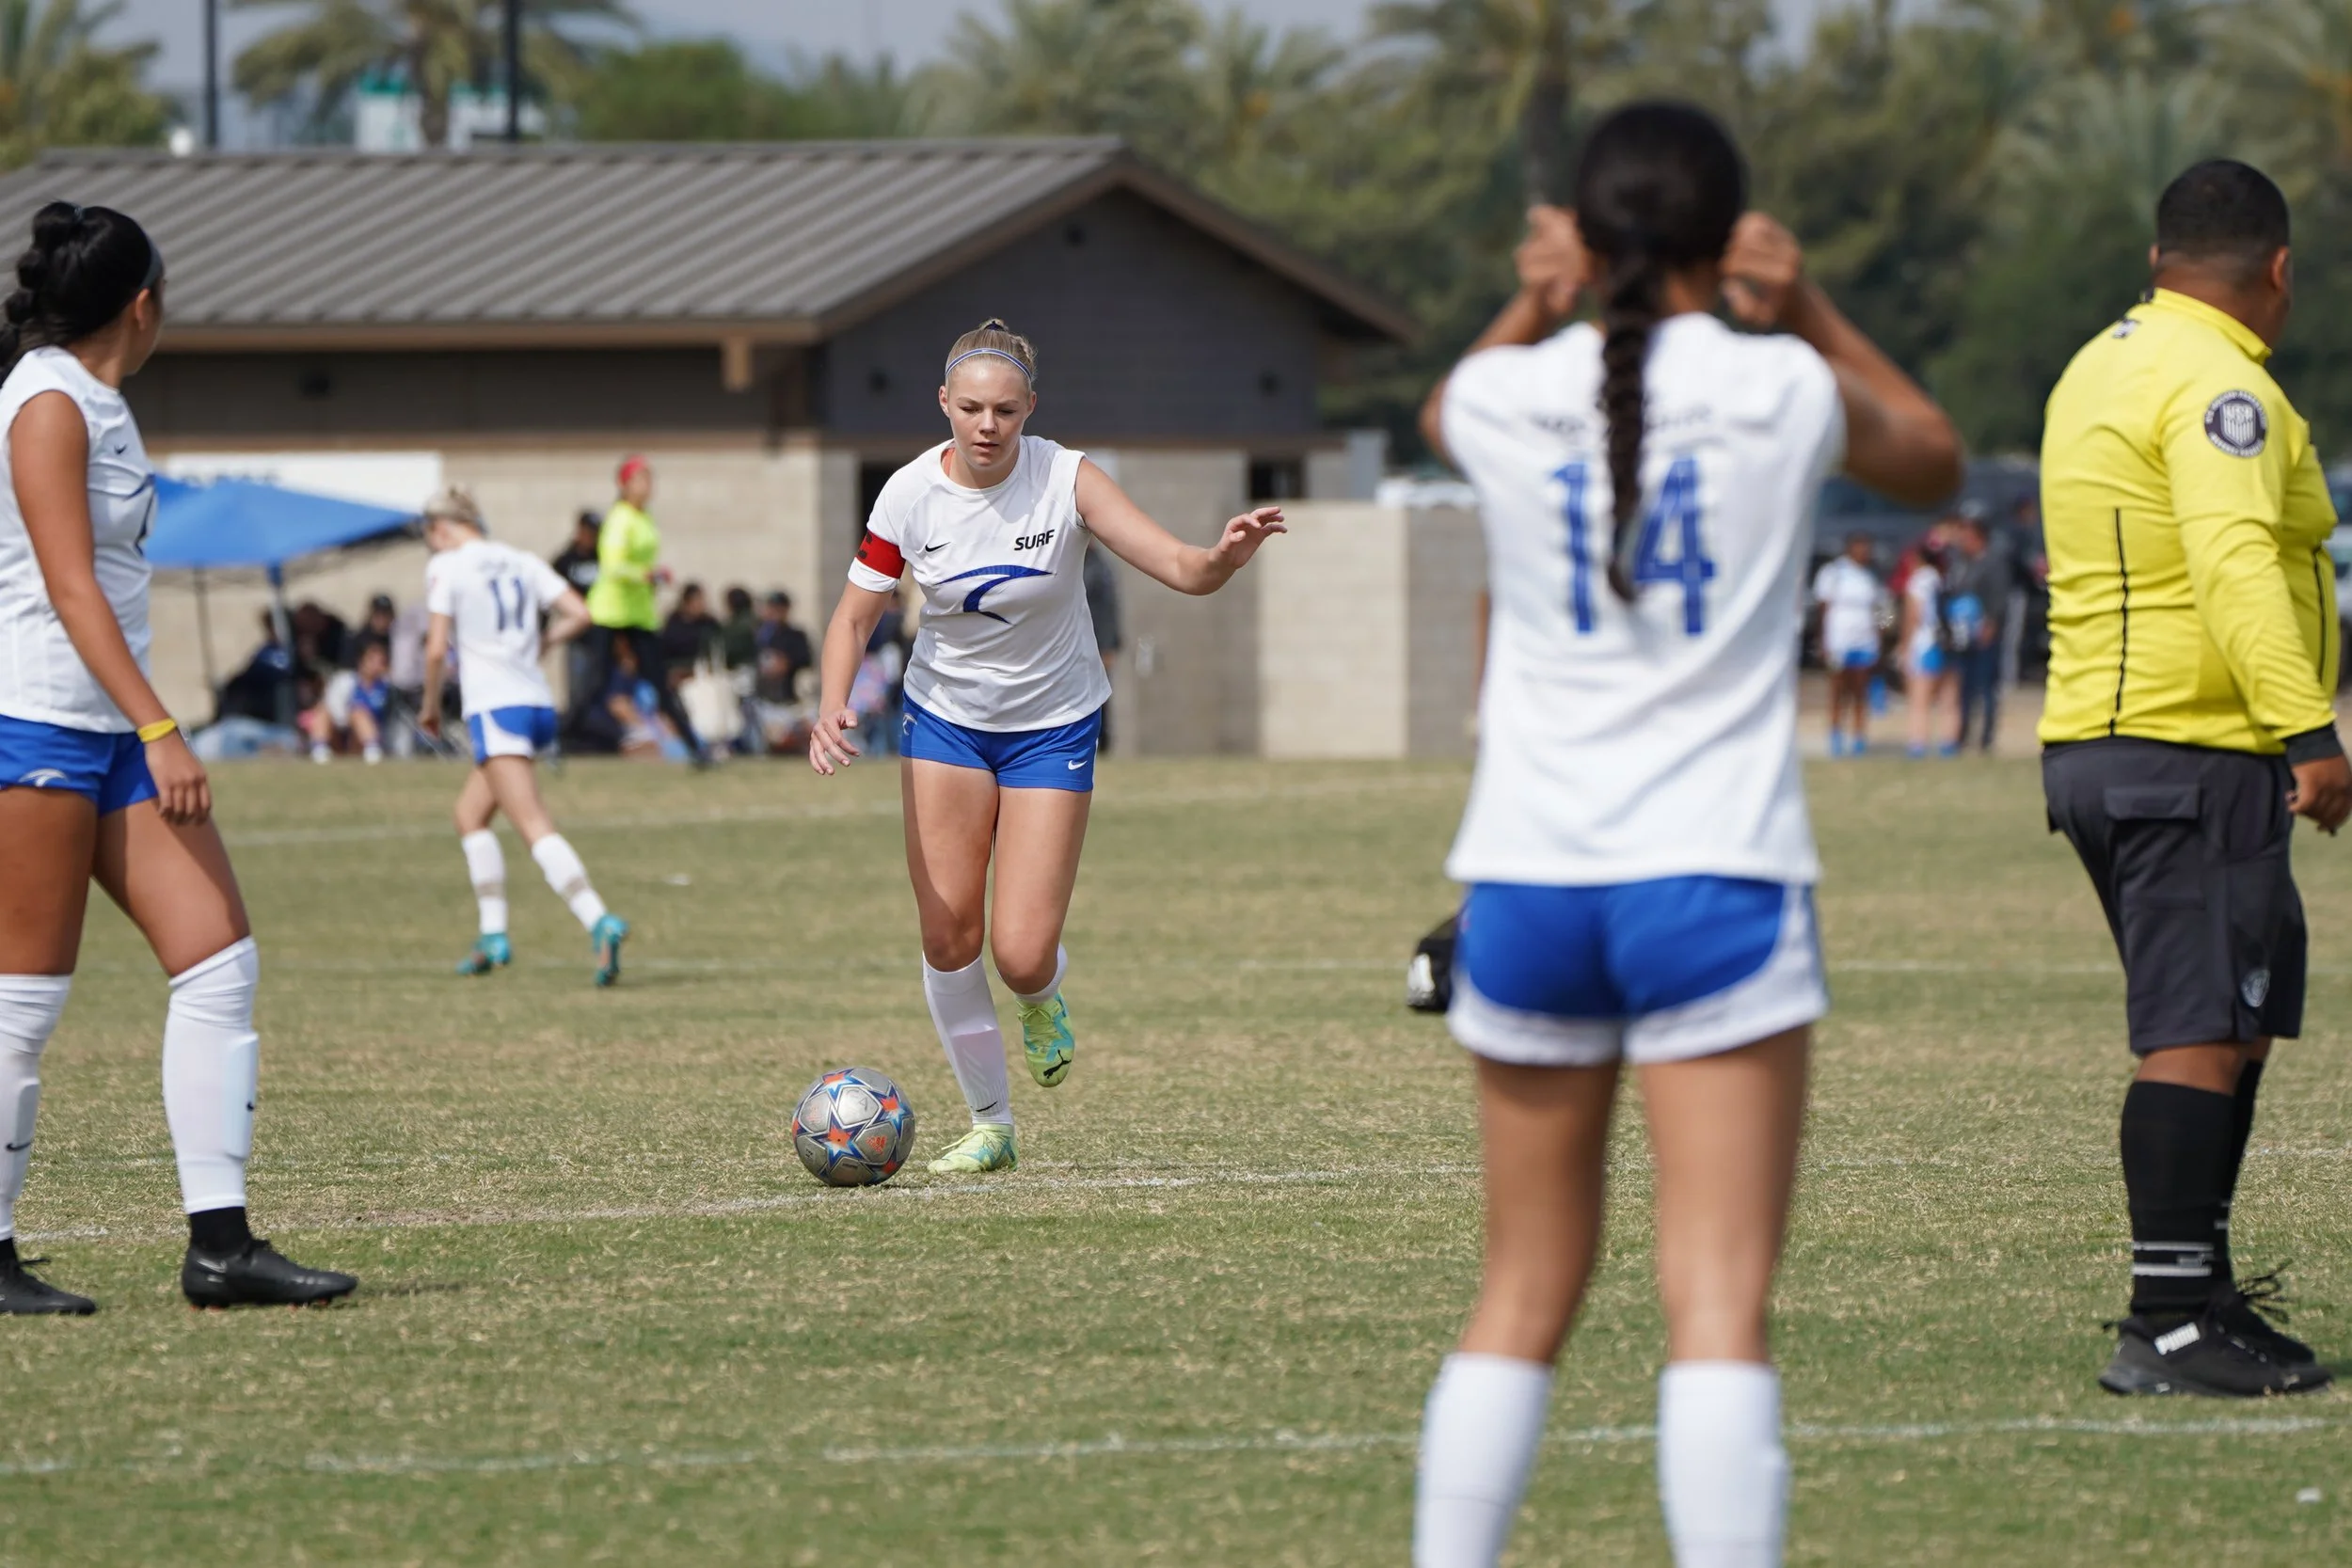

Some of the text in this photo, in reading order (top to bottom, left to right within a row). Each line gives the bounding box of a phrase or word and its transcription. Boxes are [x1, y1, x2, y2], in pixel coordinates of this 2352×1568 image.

[1013, 529, 1056, 551] SURF
[1549, 456, 1718, 634] 14
[487, 577, 525, 631] 11
